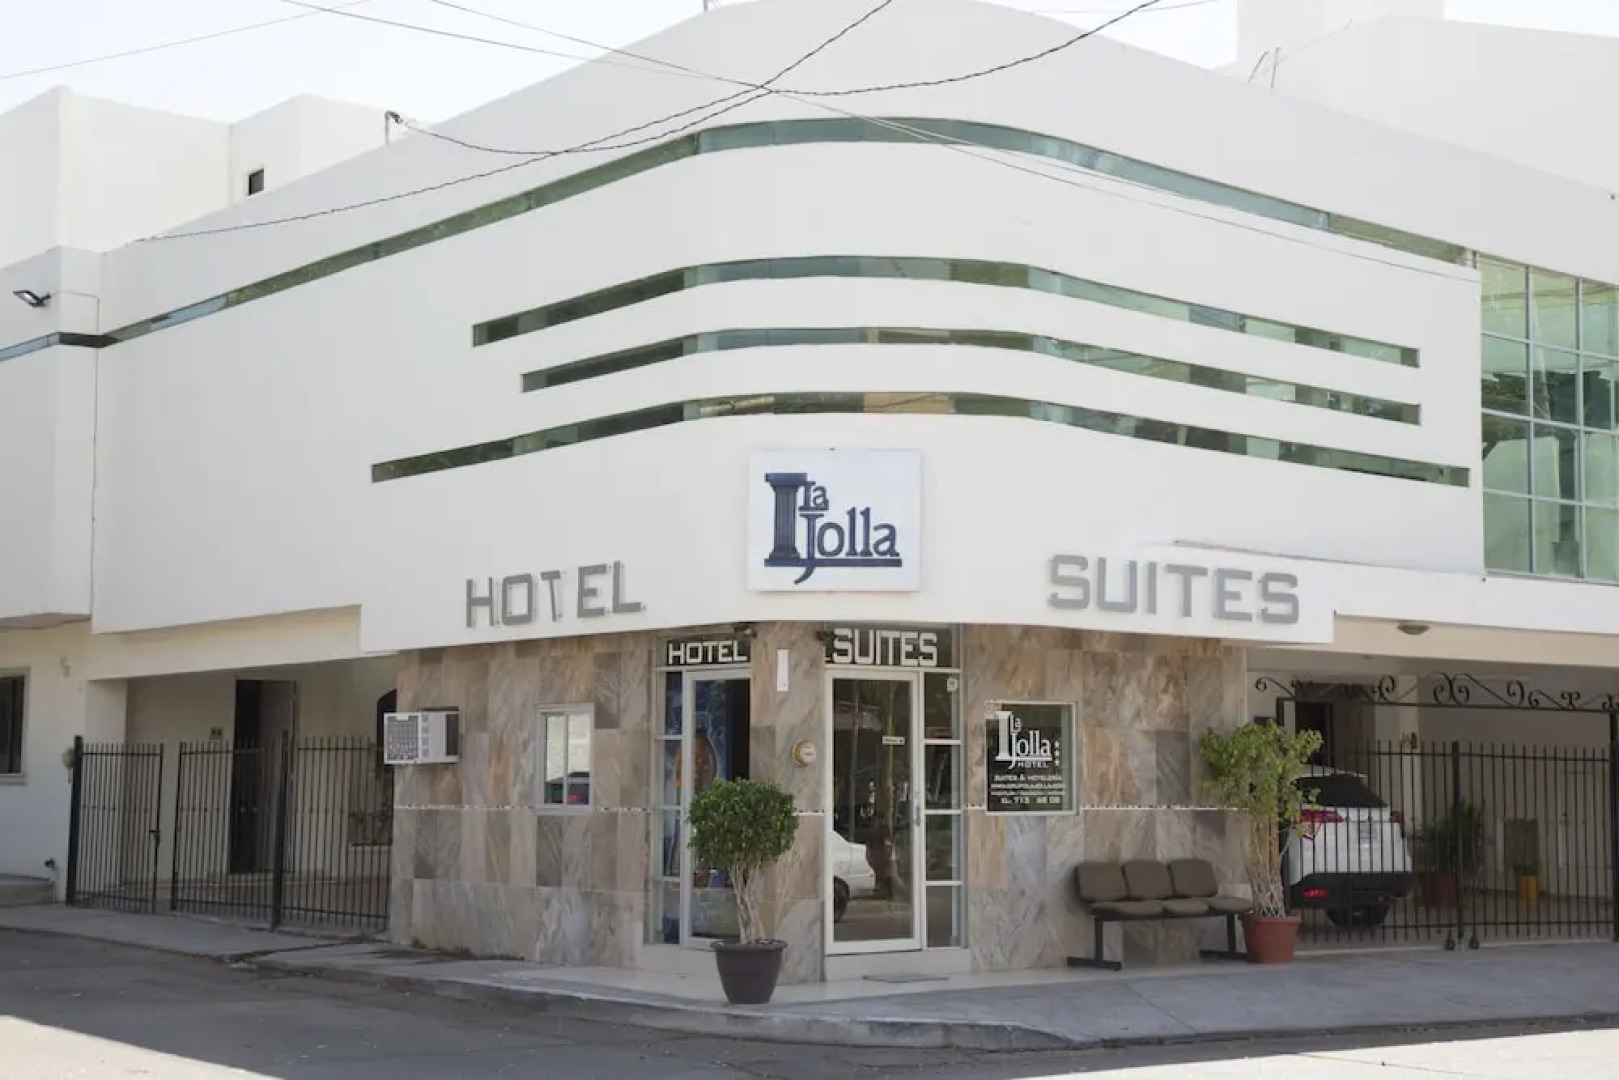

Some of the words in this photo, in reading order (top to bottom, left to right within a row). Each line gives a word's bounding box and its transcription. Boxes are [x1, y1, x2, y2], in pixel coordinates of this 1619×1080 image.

[794, 506, 900, 585] Jolla
[466, 560, 642, 628] HOTEL
[1047, 554, 1299, 624] SUITES
[667, 639, 748, 665] HOTEL
[832, 627, 938, 667] SUITES
[1018, 760, 1050, 768] HOTEL
